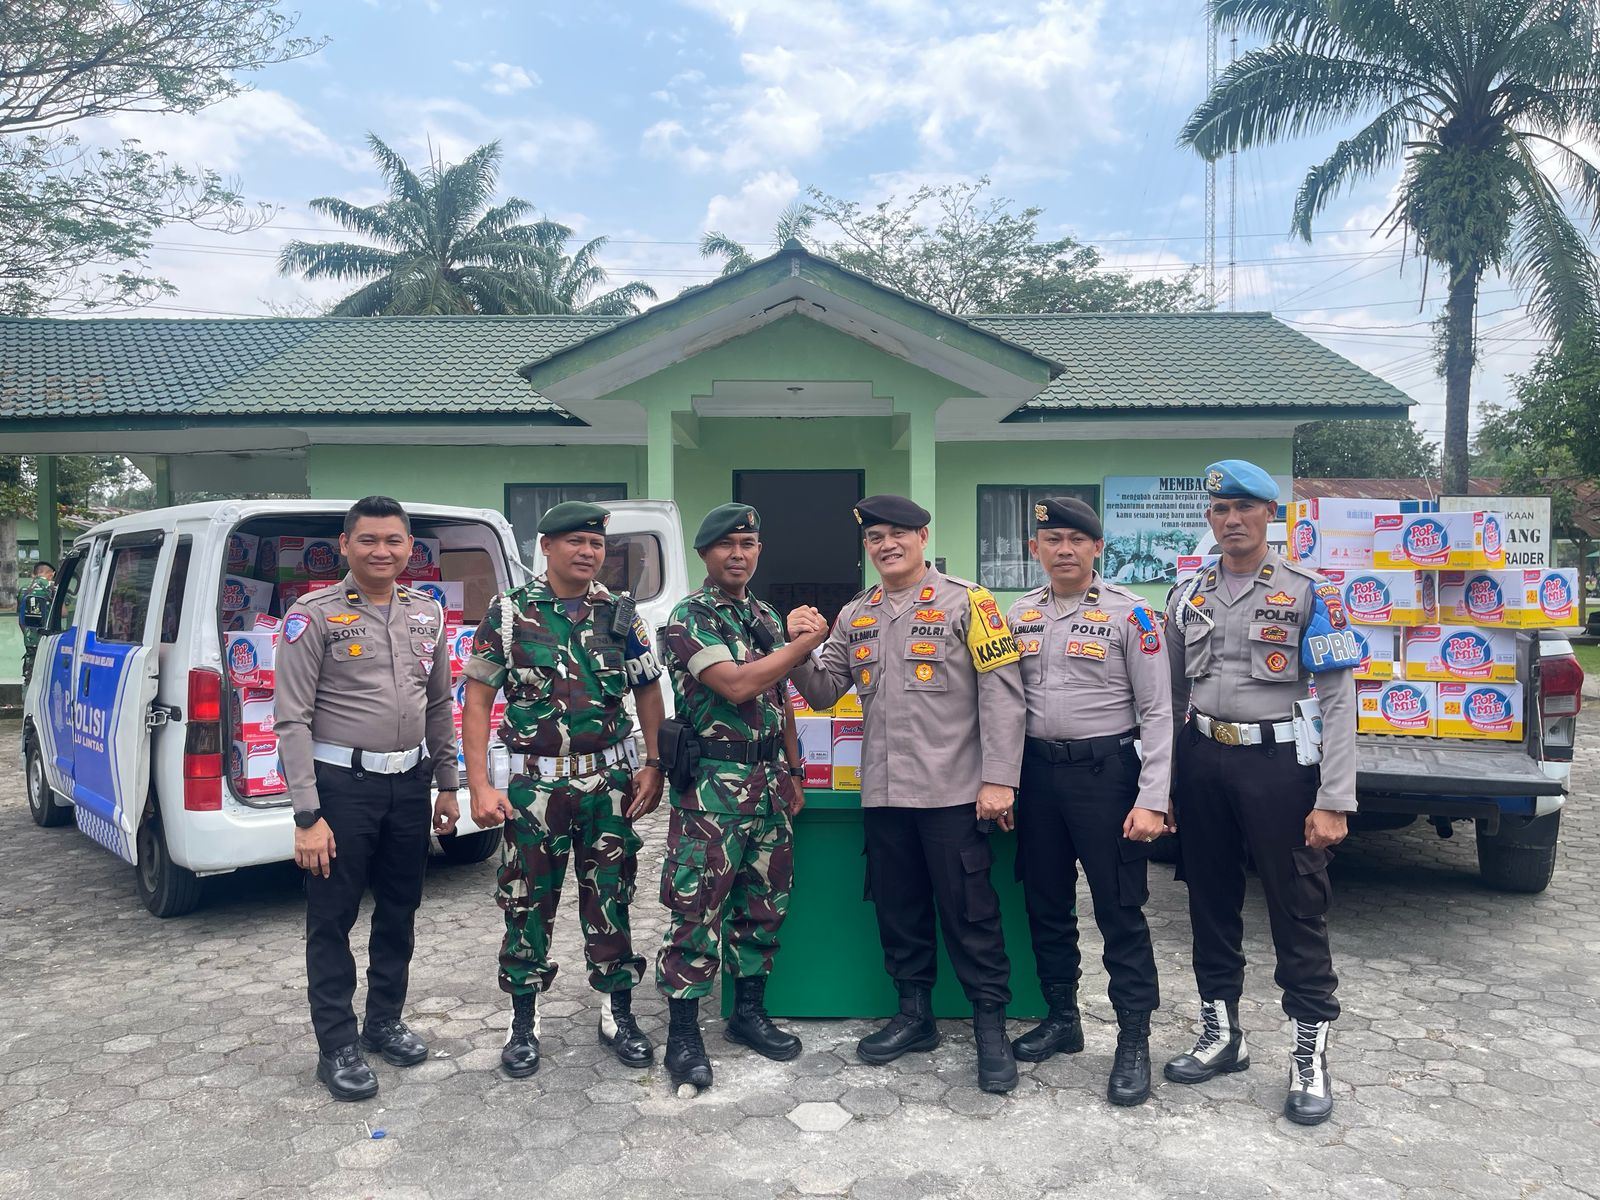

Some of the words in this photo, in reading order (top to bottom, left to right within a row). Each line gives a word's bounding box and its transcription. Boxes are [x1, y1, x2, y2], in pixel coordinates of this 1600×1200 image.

[1411, 524, 1434, 539] POP
[1415, 534, 1440, 547] MIE
[1505, 552, 1544, 565] RAIDER
[1353, 581, 1376, 595] POP
[1471, 581, 1491, 594] POP
[1545, 578, 1561, 593] POP
[1357, 591, 1382, 604] MIE
[1474, 590, 1496, 604] MIE
[1548, 588, 1565, 601] MIE
[1255, 609, 1300, 623] POLRI
[332, 627, 367, 641] SONY
[911, 626, 944, 636] POLRI
[1071, 624, 1111, 637] POLRI
[233, 643, 248, 656] POP
[1450, 637, 1475, 651] POP
[236, 652, 253, 666] MIE
[1455, 646, 1482, 660] MIE
[1389, 690, 1412, 703] POP
[1473, 693, 1496, 706] POP
[1394, 699, 1419, 711] MIE
[1477, 702, 1503, 715] MIE
[82, 738, 104, 753] LINTAS
